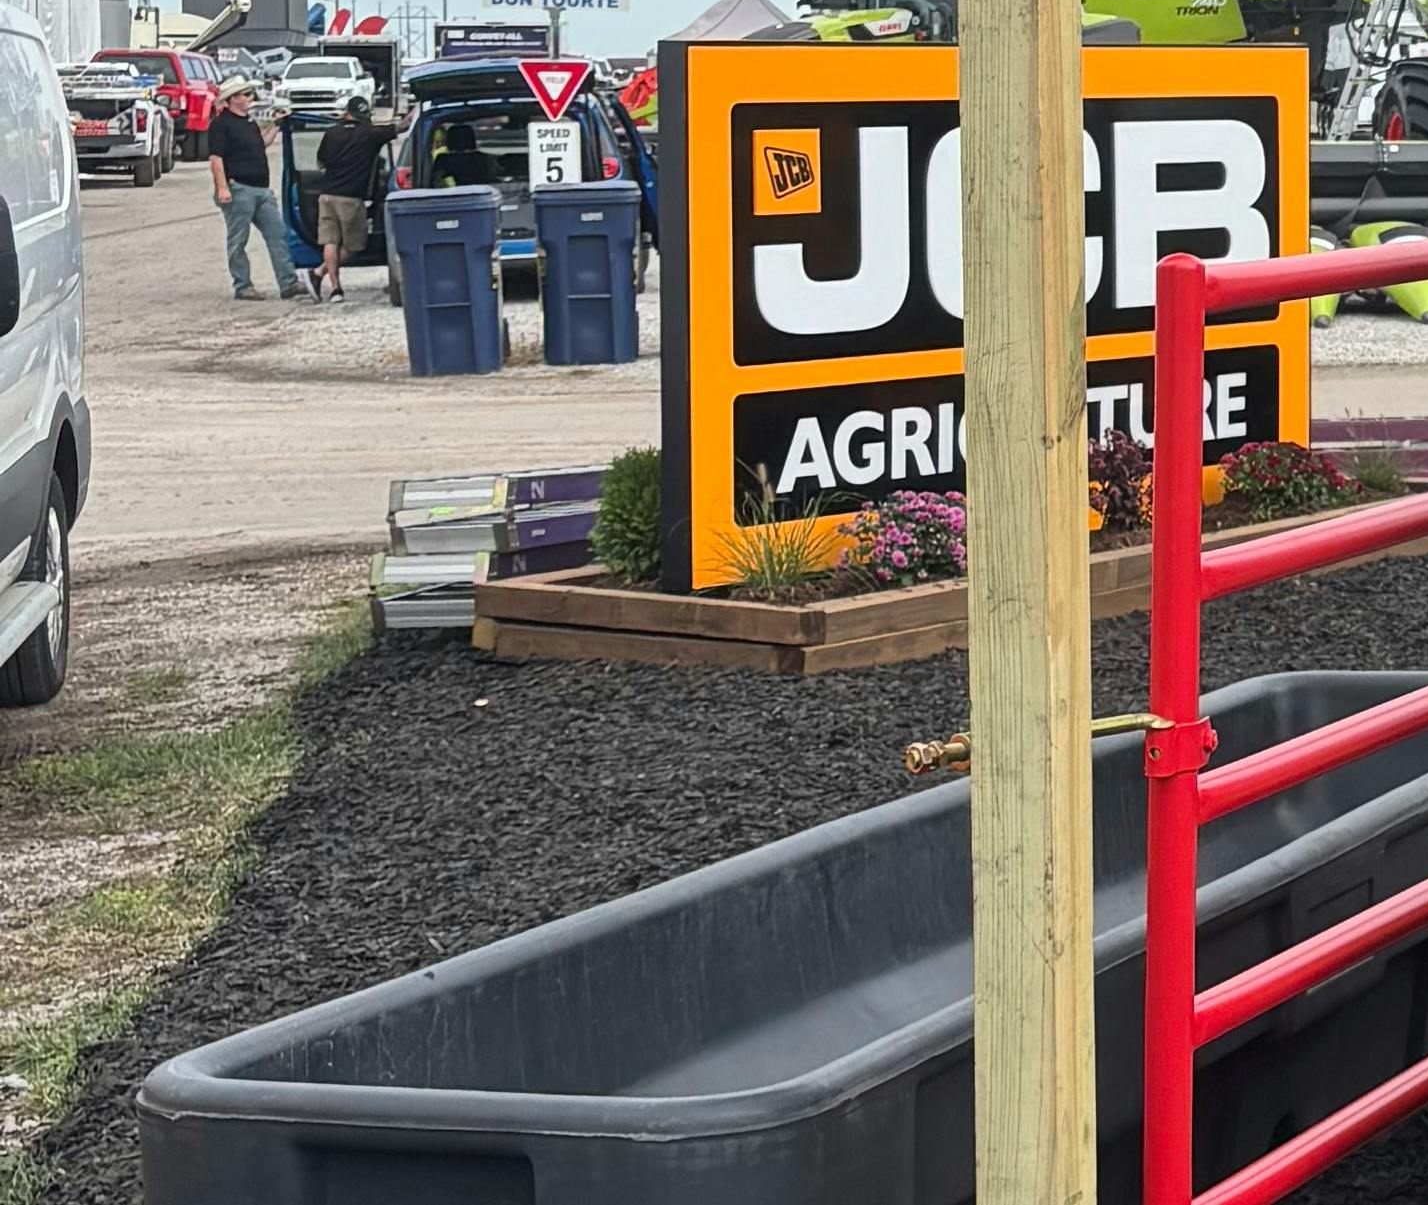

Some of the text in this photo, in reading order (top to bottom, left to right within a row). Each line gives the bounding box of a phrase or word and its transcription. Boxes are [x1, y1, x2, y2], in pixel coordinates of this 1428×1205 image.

[1175, 6, 1219, 16] TRION
[537, 128, 570, 139] SPEED
[540, 142, 568, 153] LIMIT
[546, 157, 564, 183] 5
[773, 152, 811, 193] JCB
